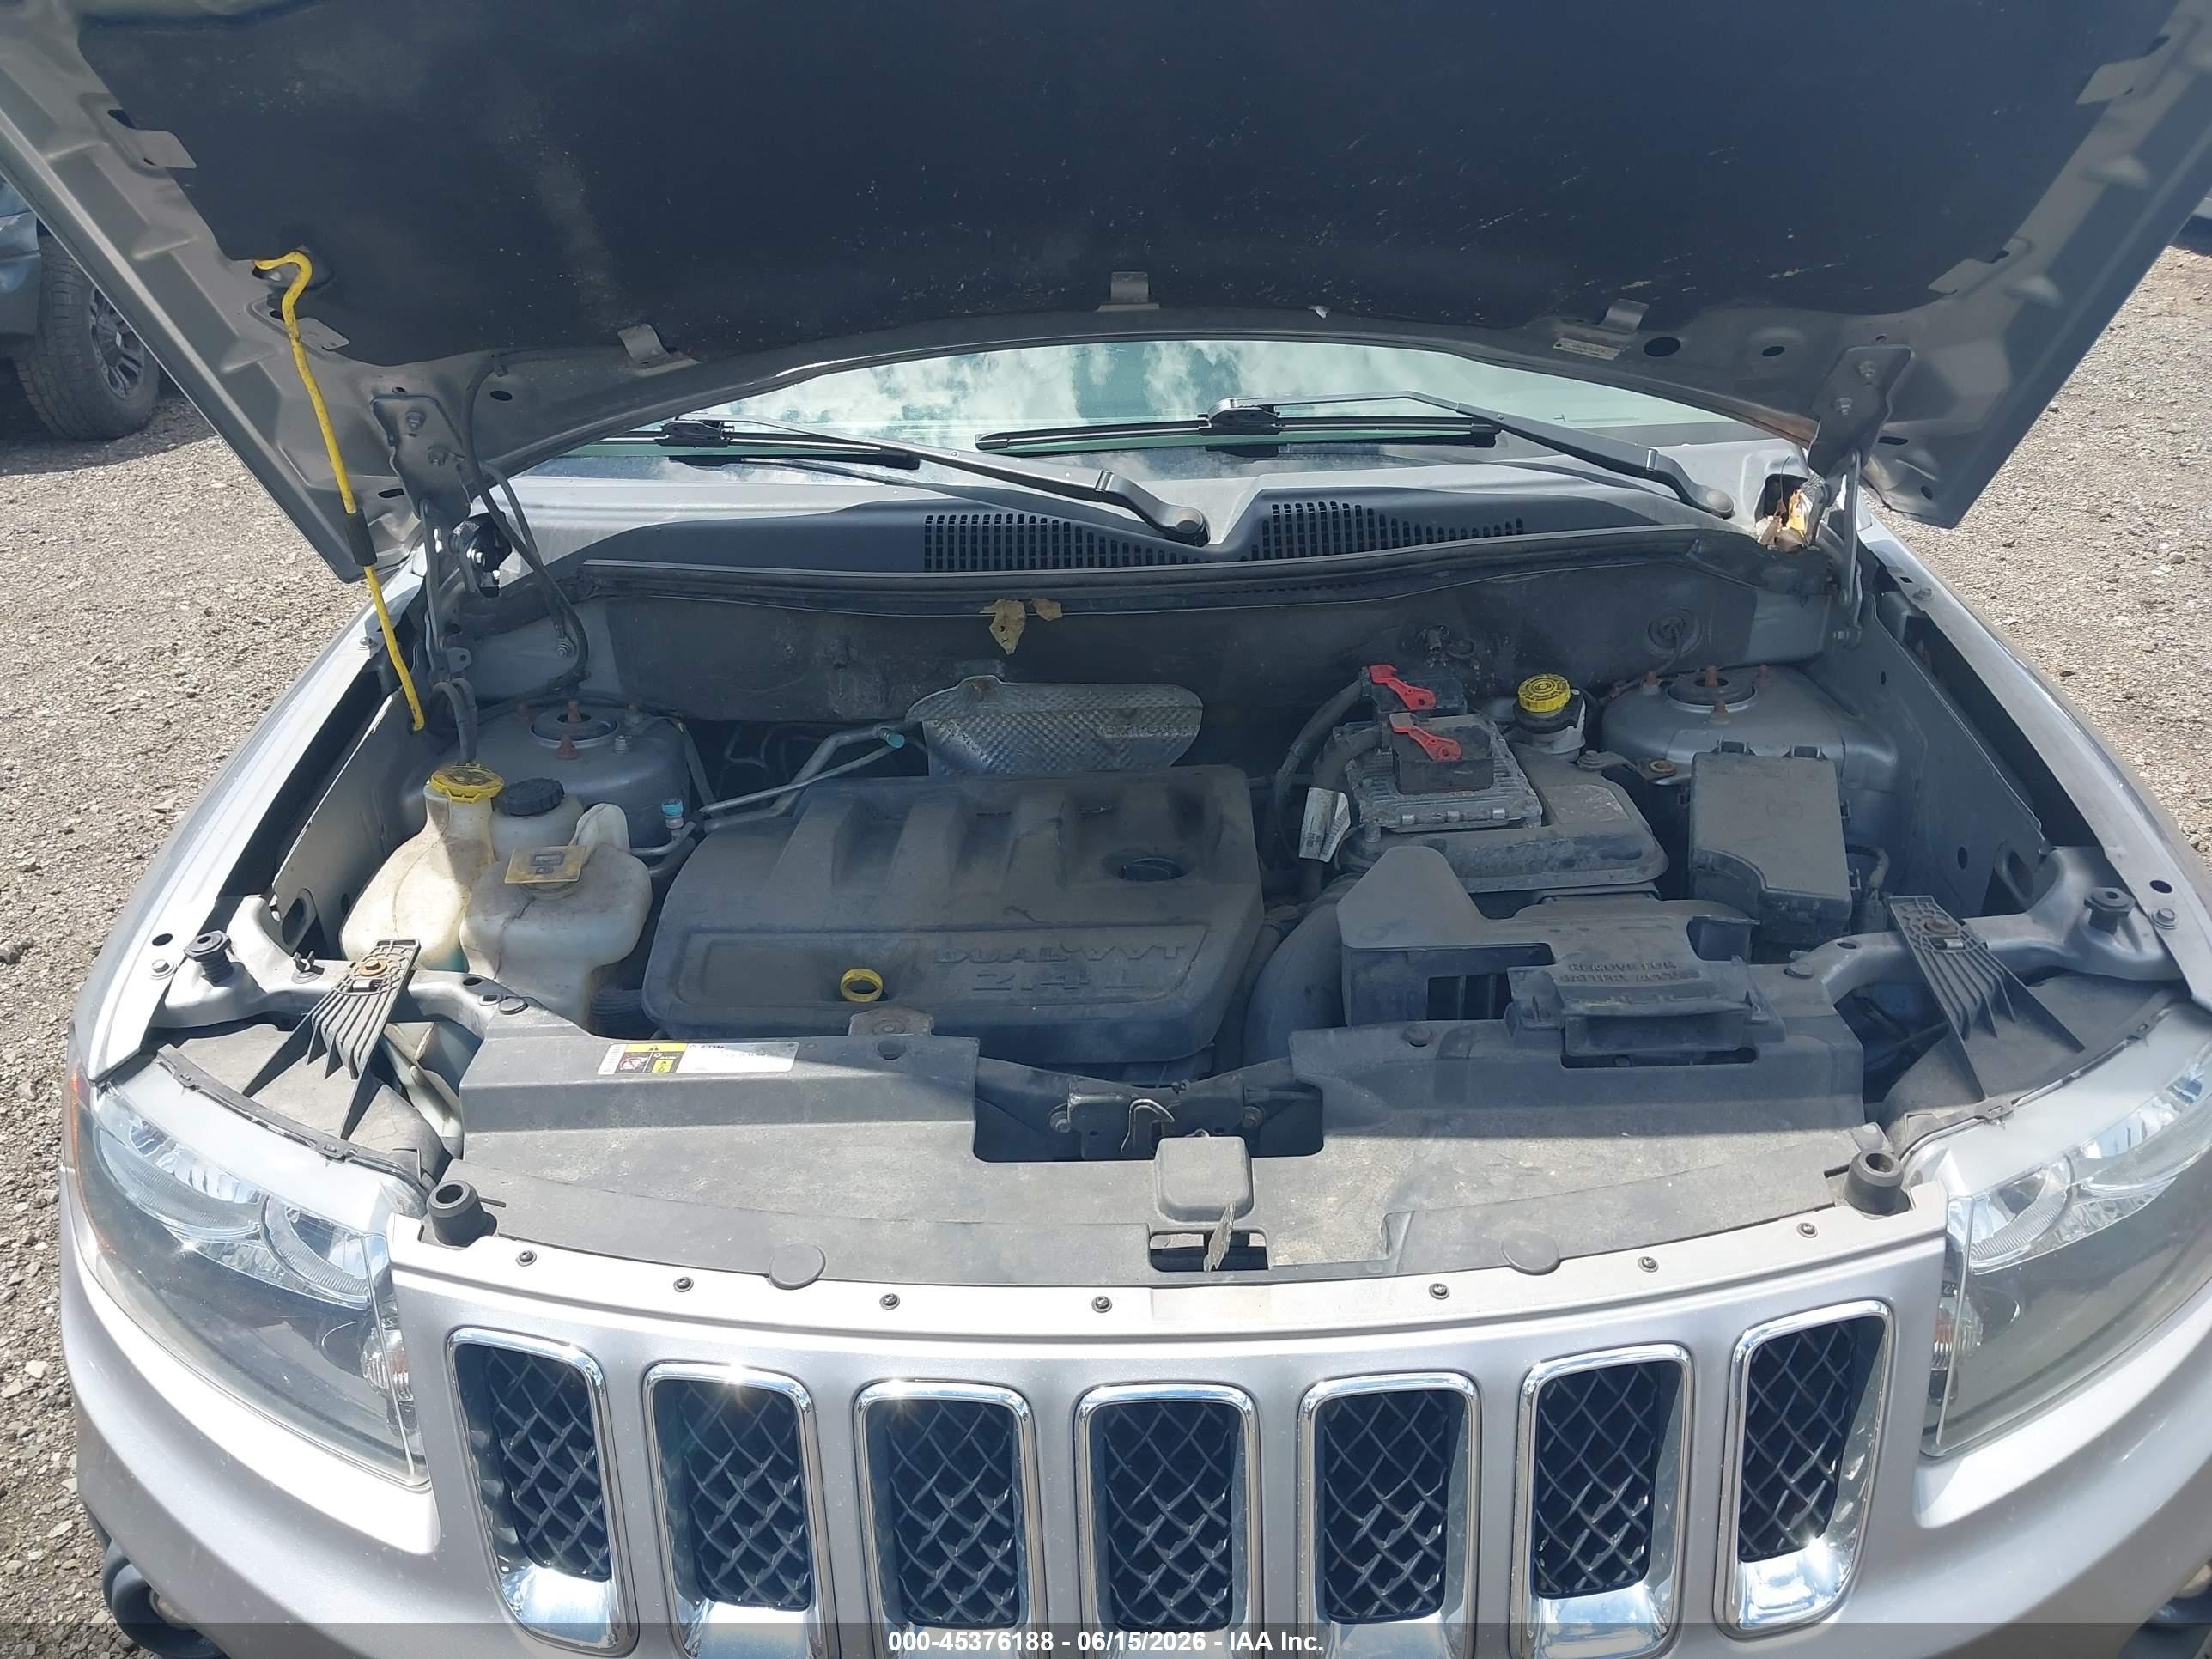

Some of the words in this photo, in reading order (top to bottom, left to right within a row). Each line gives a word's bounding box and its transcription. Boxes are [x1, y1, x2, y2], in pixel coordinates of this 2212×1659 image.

[933, 946, 1067, 964] DUAL
[1079, 944, 1186, 962] VVT
[1568, 961, 1635, 972] REMOVE
[1640, 960, 1677, 970] FOR
[1559, 974, 1629, 984] BATTERY
